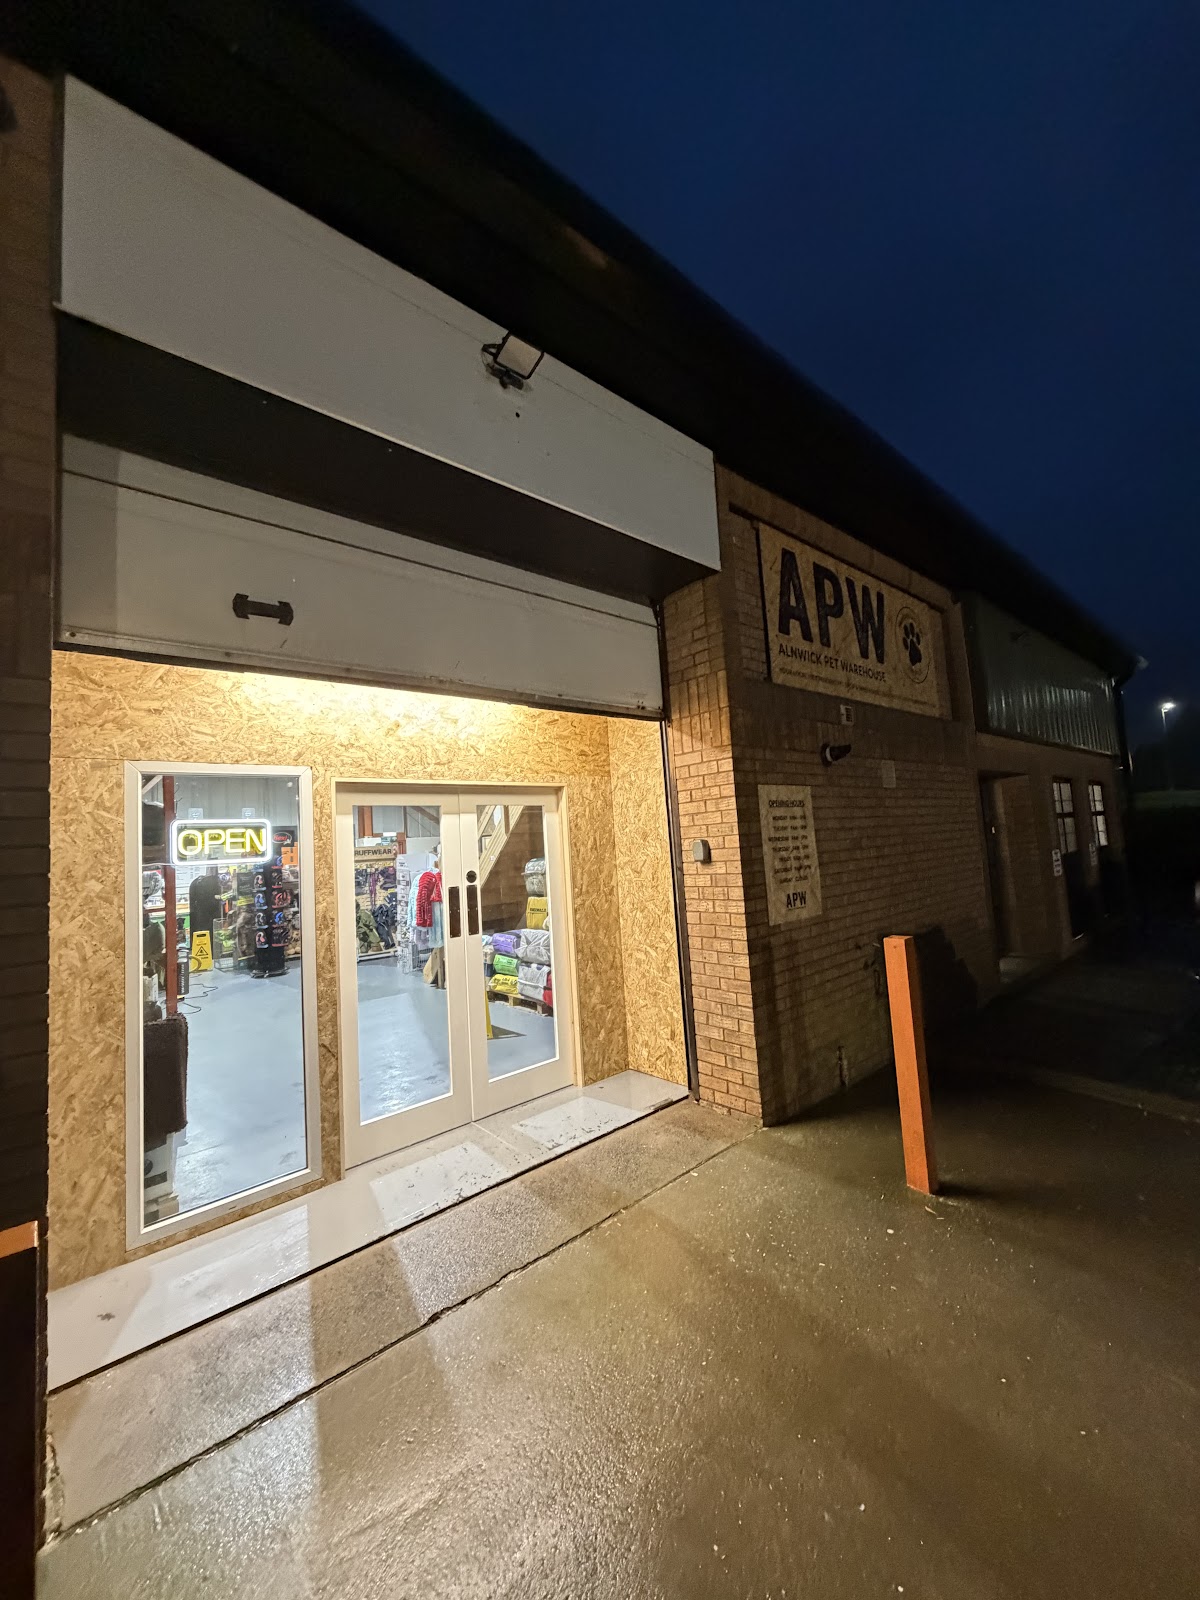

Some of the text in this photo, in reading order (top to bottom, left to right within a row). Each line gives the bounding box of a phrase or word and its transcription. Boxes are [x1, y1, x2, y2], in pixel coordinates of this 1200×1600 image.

[778, 547, 885, 665] APW
[778, 643, 887, 682] ALNWICK PET WAREHOUSE
[177, 828, 267, 856] OPEN
[354, 848, 392, 856] RUFFWEAR
[786, 891, 806, 908] APW
